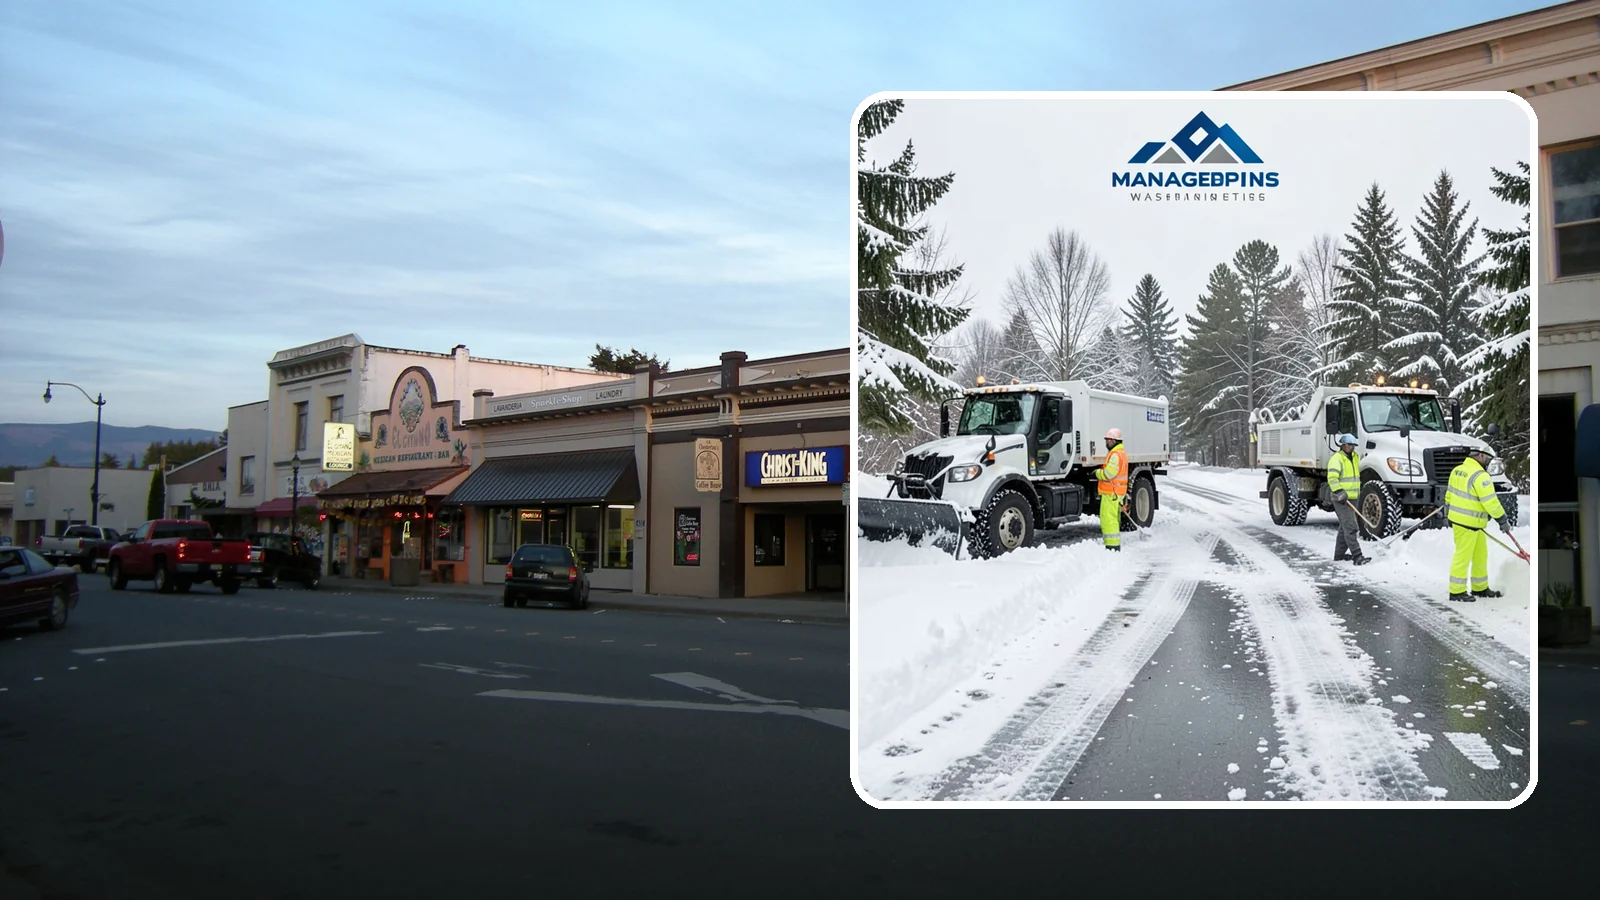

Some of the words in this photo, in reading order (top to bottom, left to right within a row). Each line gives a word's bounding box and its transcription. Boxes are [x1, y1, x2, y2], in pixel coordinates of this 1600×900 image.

[596, 389, 624, 400] LAUNDRY
[493, 401, 523, 413] LAVANDERIA
[374, 453, 396, 464] MEXICAN
[397, 450, 433, 462] RESTAURANT
[438, 450, 450, 459] BAR
[760, 452, 798, 478] CHRIST
[799, 450, 828, 476] KING
[697, 480, 709, 489] Coffee
[710, 480, 722, 489] House
